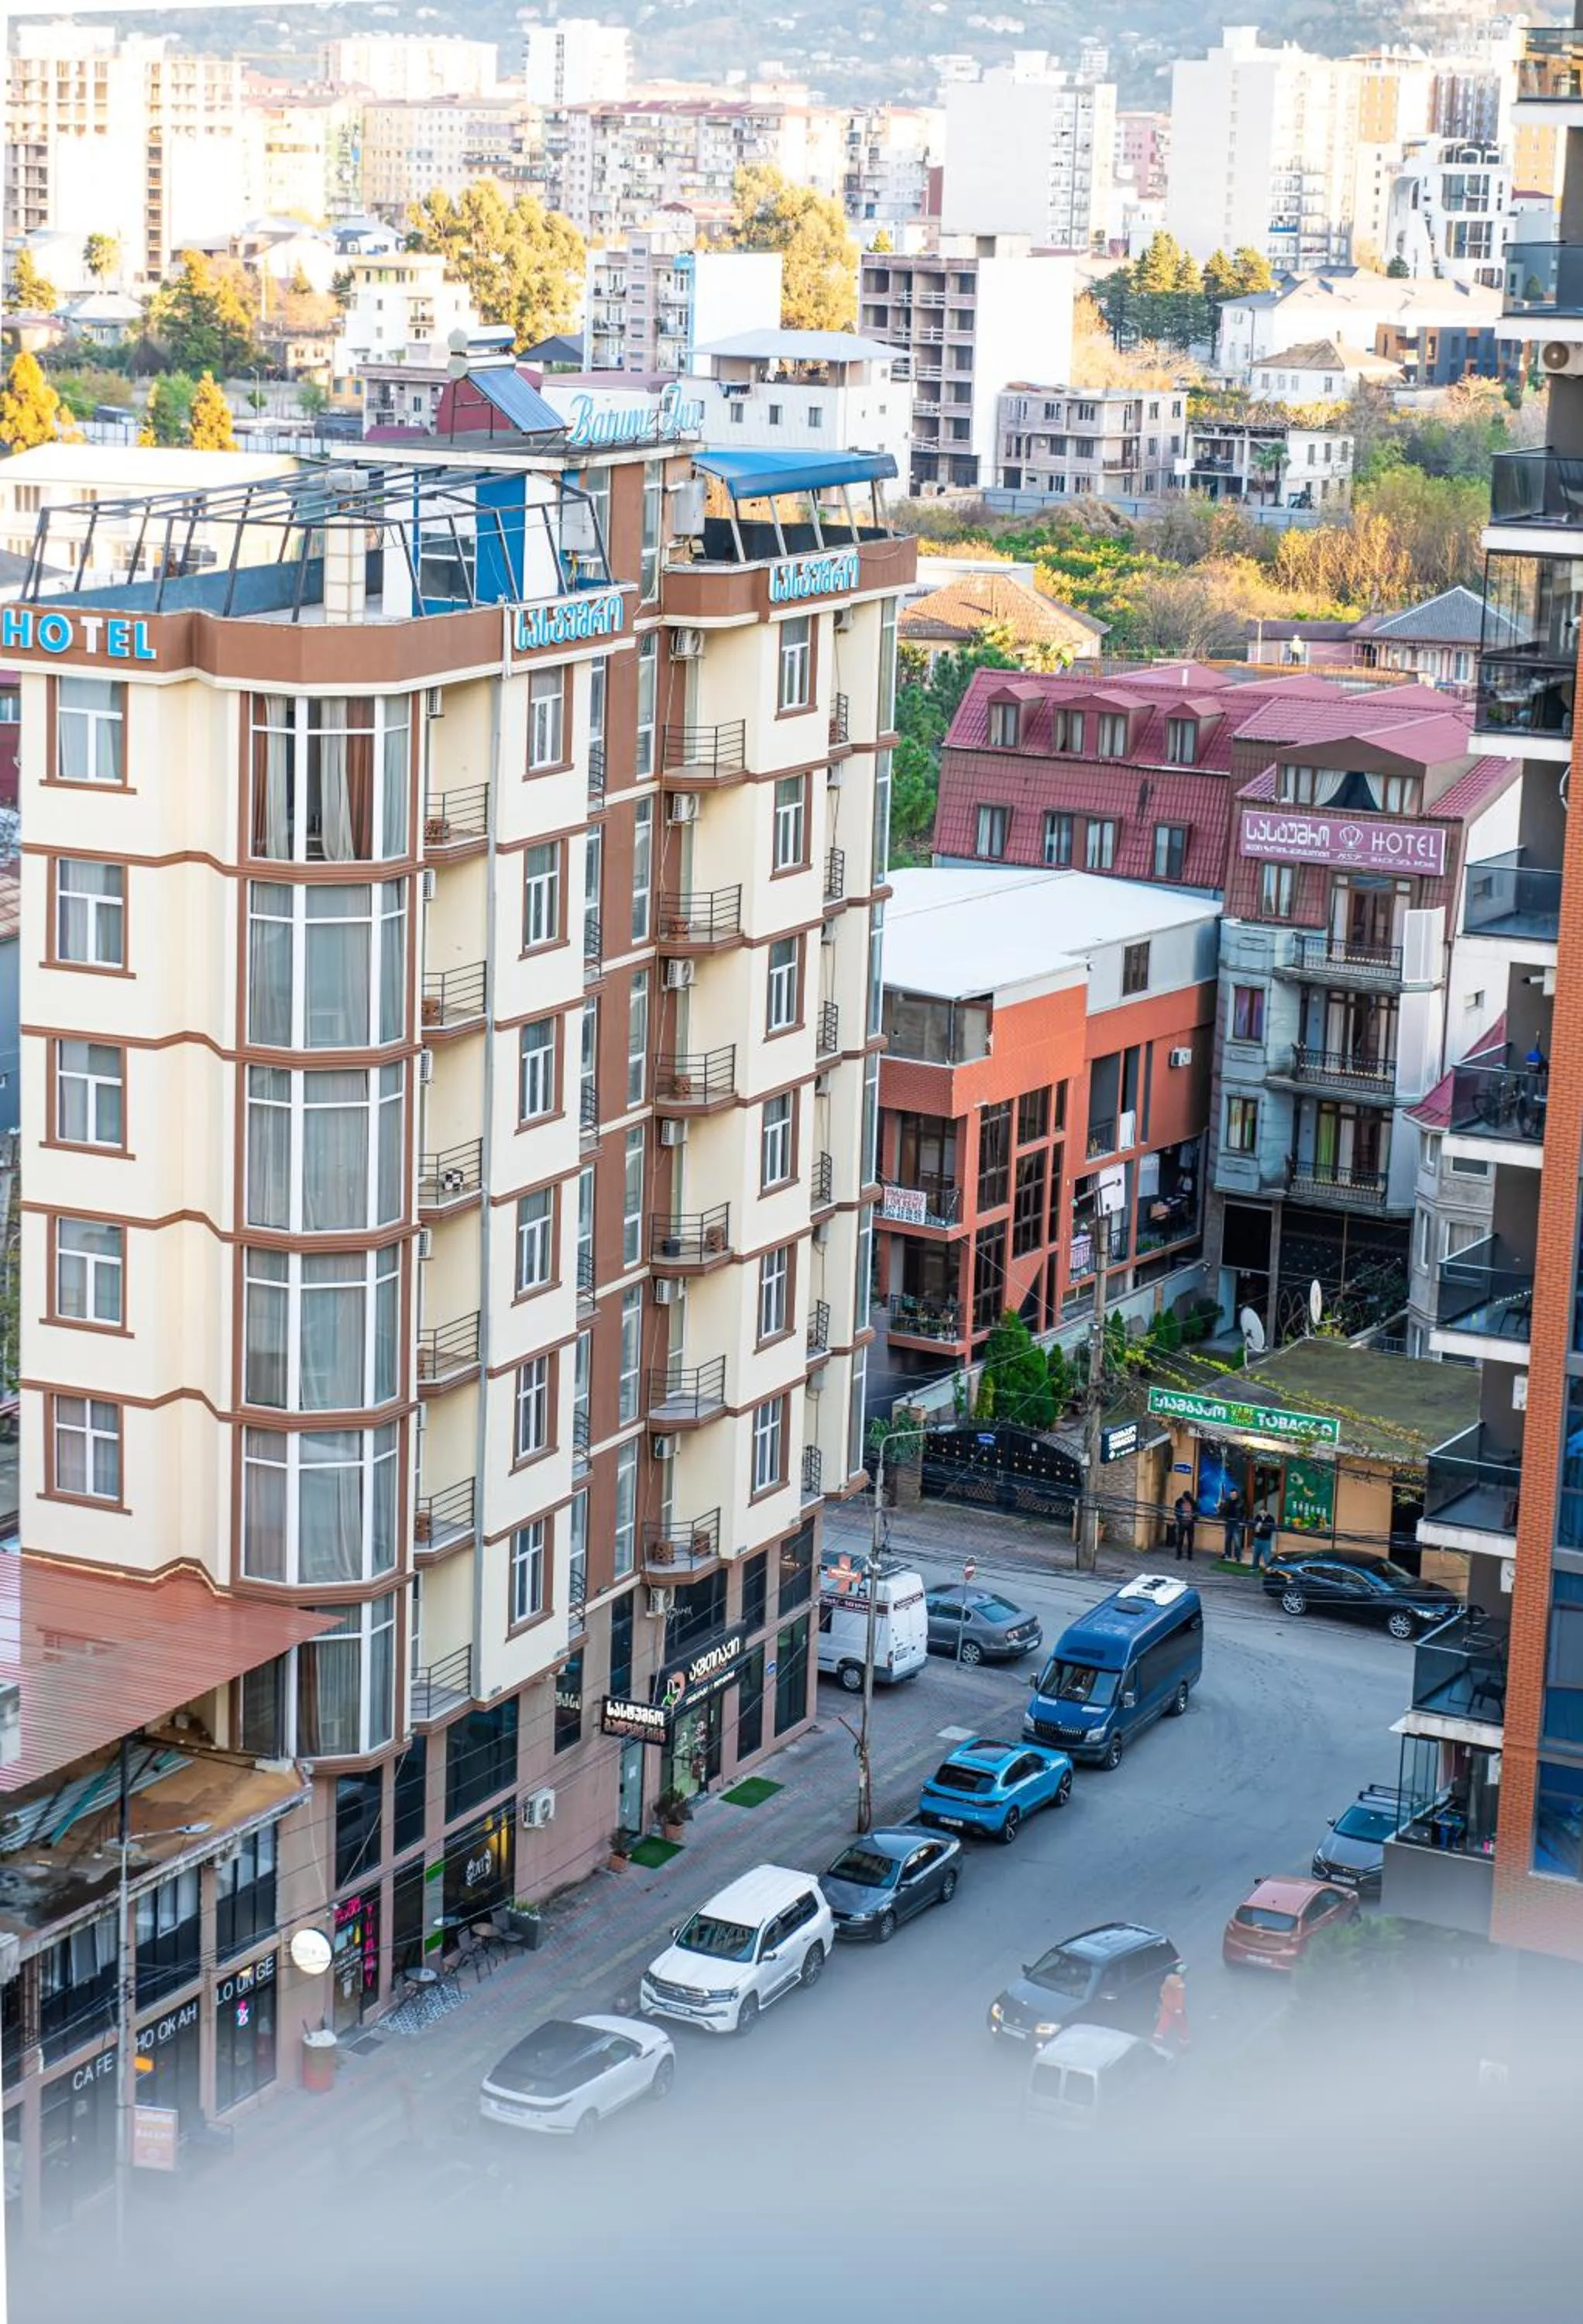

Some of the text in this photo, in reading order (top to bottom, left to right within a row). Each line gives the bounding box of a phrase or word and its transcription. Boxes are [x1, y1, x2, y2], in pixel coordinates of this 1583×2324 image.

[769, 553, 860, 603] სასტუმრო
[2, 607, 157, 661] HOTEL
[514, 594, 624, 651] სასტუმრო
[1246, 817, 1330, 848] სასტუმრო
[1372, 830, 1437, 858] HOTEL
[606, 1700, 664, 1727] სასტუმრო
[73, 2052, 113, 2091] CAFE
[136, 2002, 197, 2052] HOOKAH
[216, 1955, 274, 2006] LOUNGE
